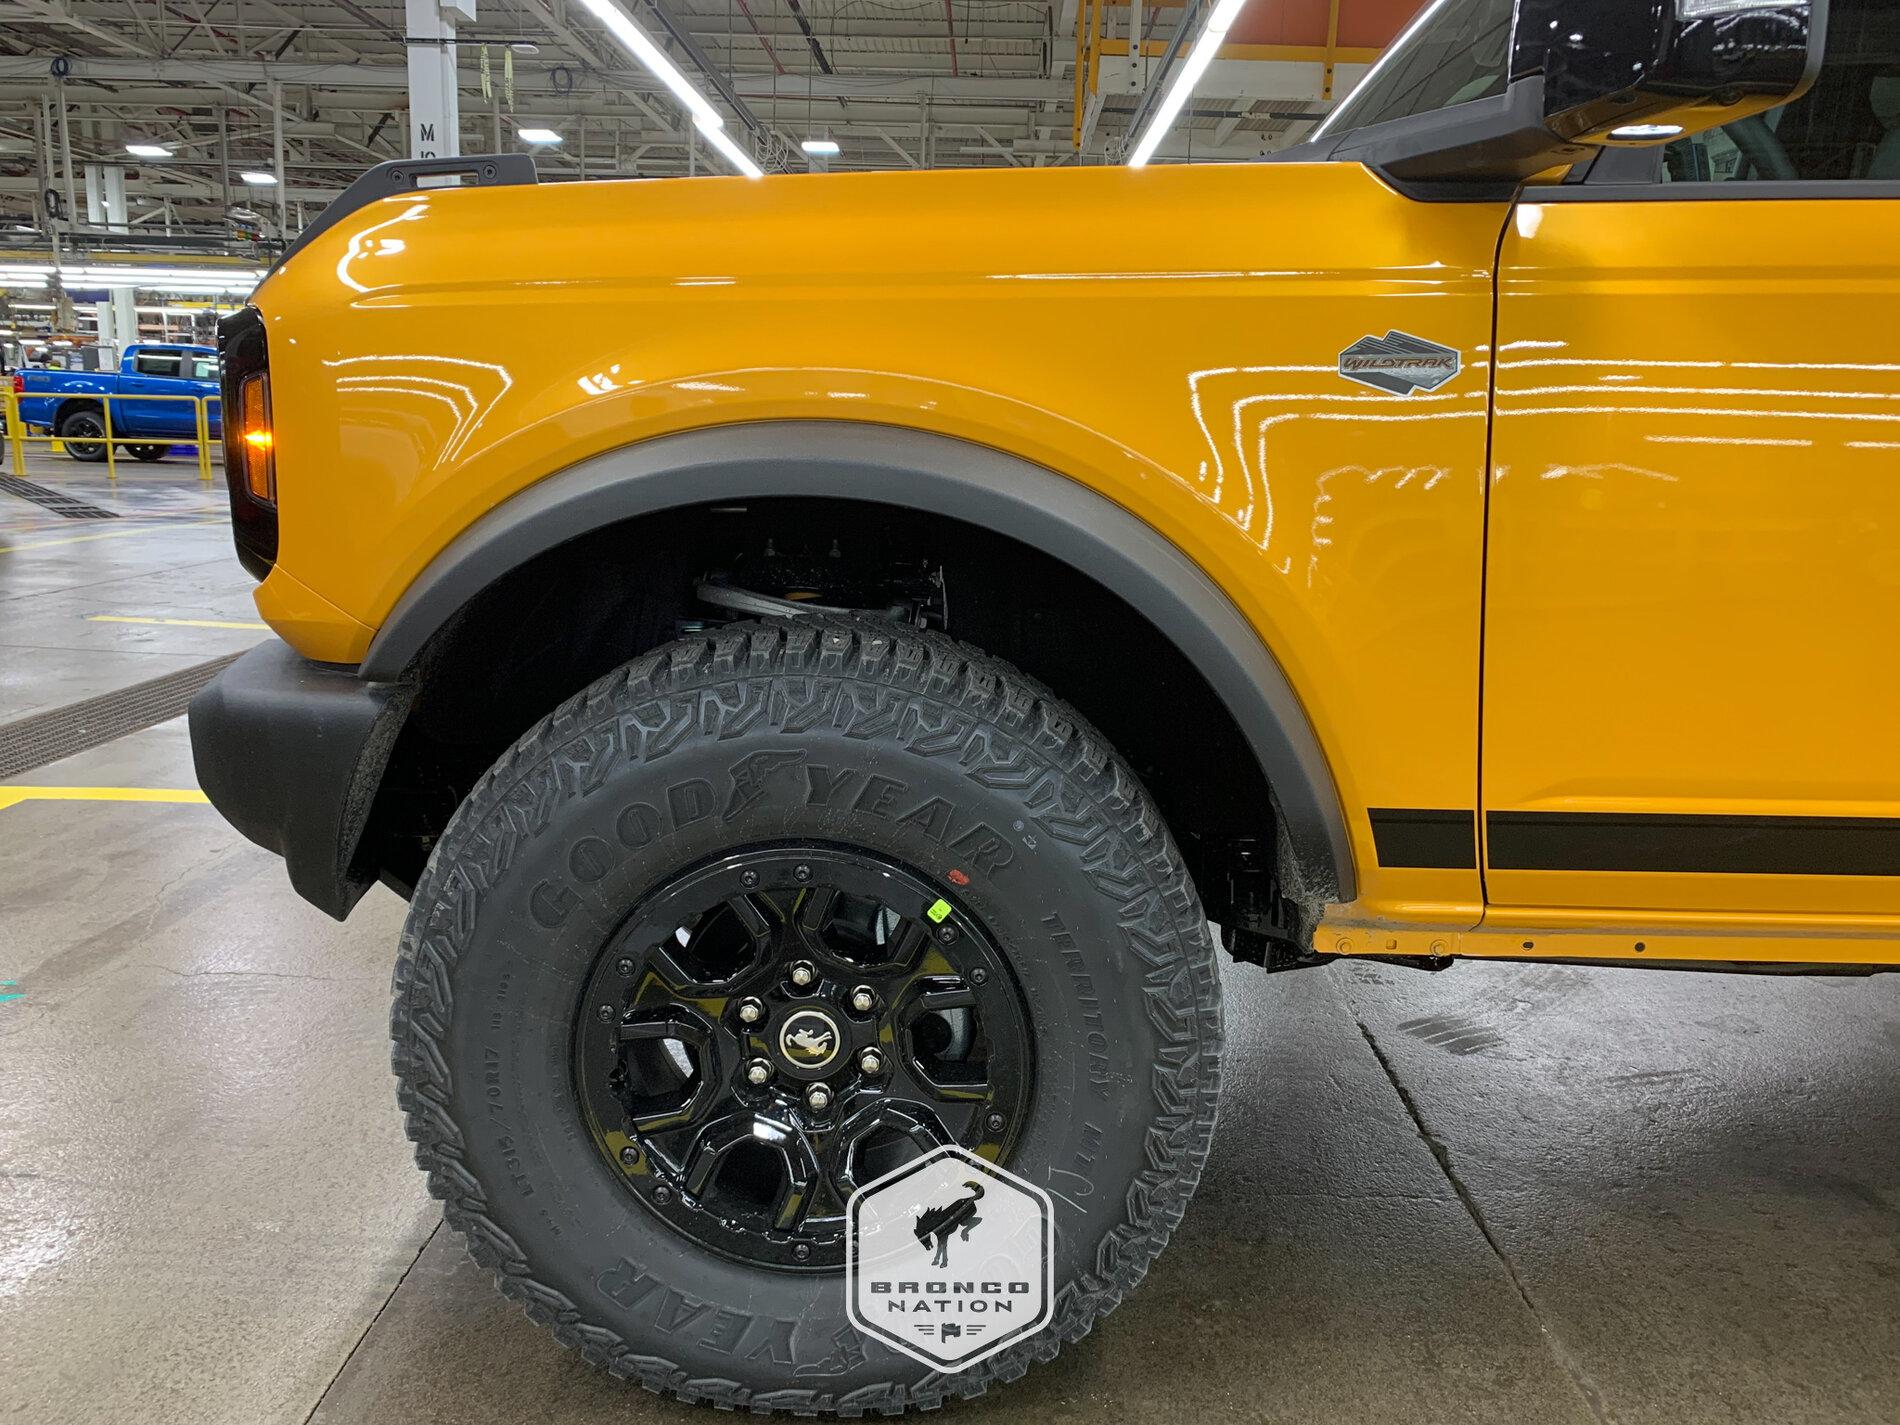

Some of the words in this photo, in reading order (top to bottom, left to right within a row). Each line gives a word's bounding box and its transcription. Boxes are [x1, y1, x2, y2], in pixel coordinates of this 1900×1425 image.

[420, 123, 435, 141] M
[1343, 357, 1455, 371] WILDTRAK
[1041, 912, 1109, 1100] TERRITORY
[596, 1256, 801, 1364] YEAR
